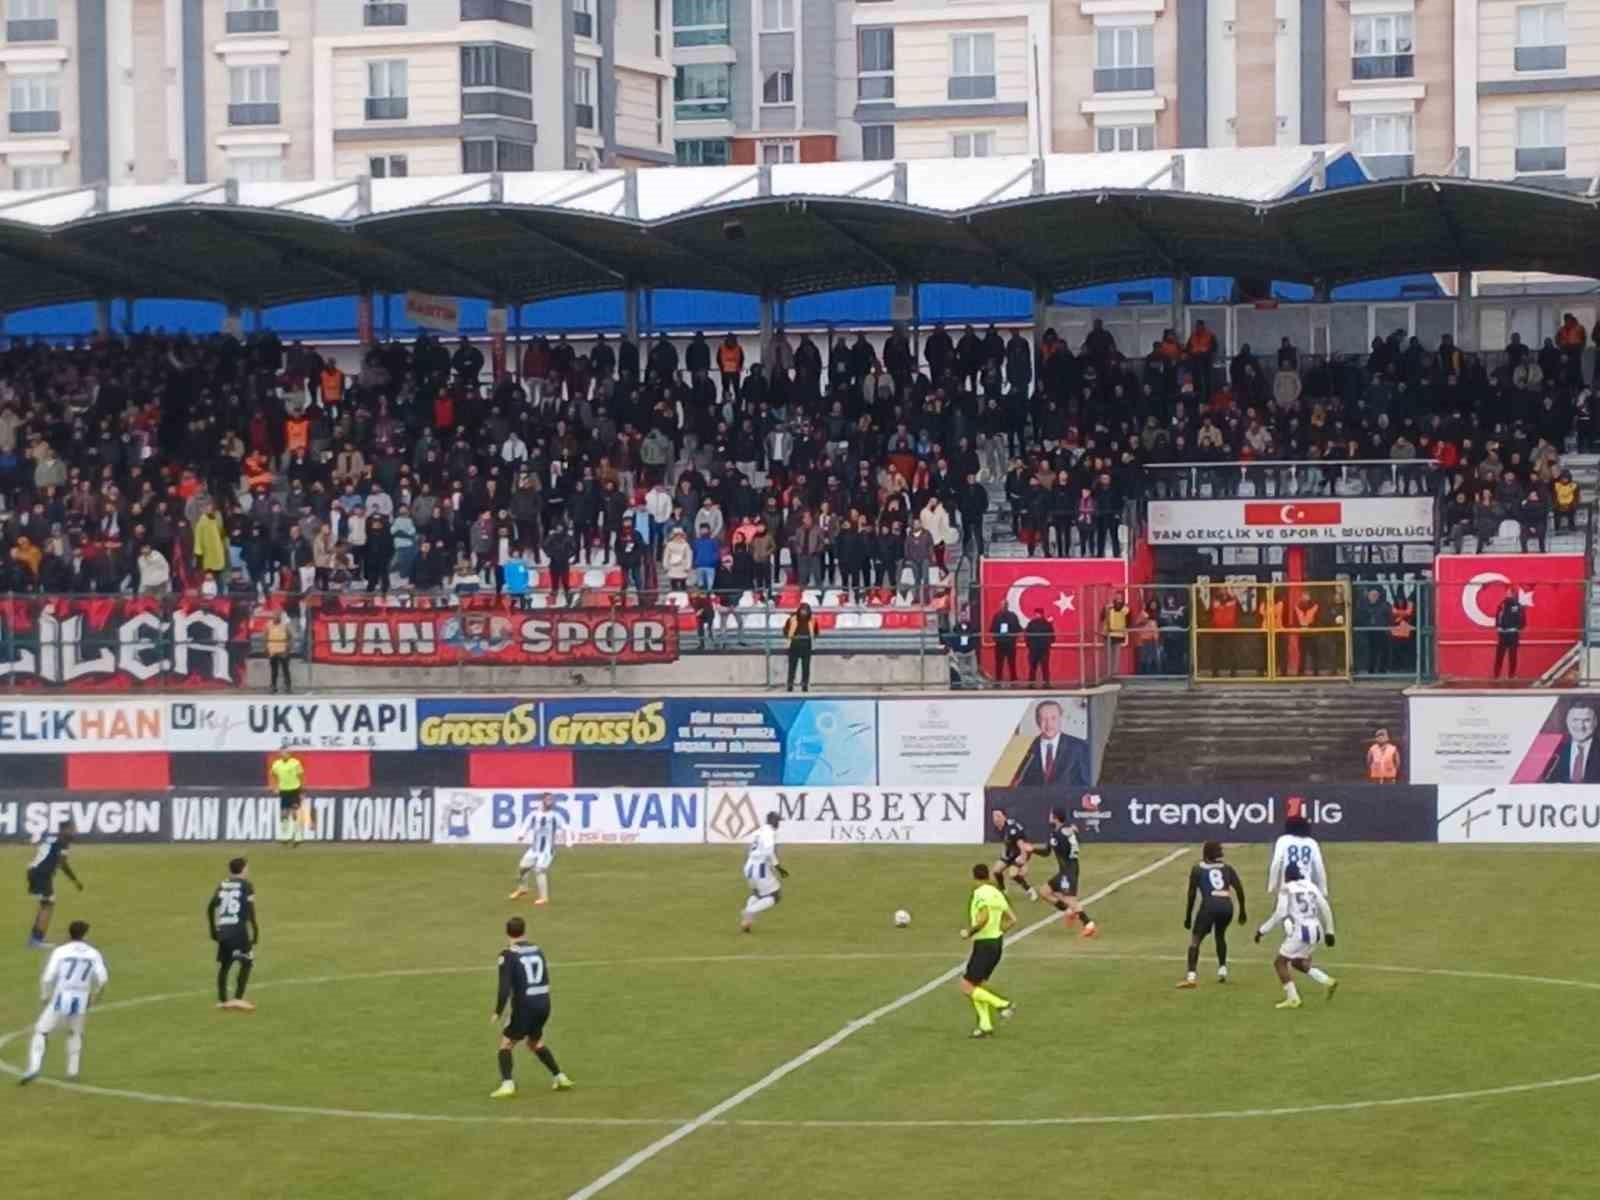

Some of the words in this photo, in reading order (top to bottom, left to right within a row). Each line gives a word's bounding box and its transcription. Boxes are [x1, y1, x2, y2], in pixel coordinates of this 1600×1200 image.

[1152, 530, 1181, 540] VAN
[1256, 529, 1274, 538] VE
[328, 621, 435, 654] VAN
[521, 619, 666, 653] SPOR
[248, 704, 320, 733] UKY
[331, 704, 408, 733] YAPI
[172, 797, 220, 840] VAN
[342, 788, 433, 840] KONAĞI
[614, 793, 697, 828] VAN
[777, 793, 970, 821] MABEYN
[1128, 798, 1274, 829] trendyol
[1288, 845, 1311, 865] 88
[64, 957, 92, 981] 77
[520, 956, 544, 984] 17
